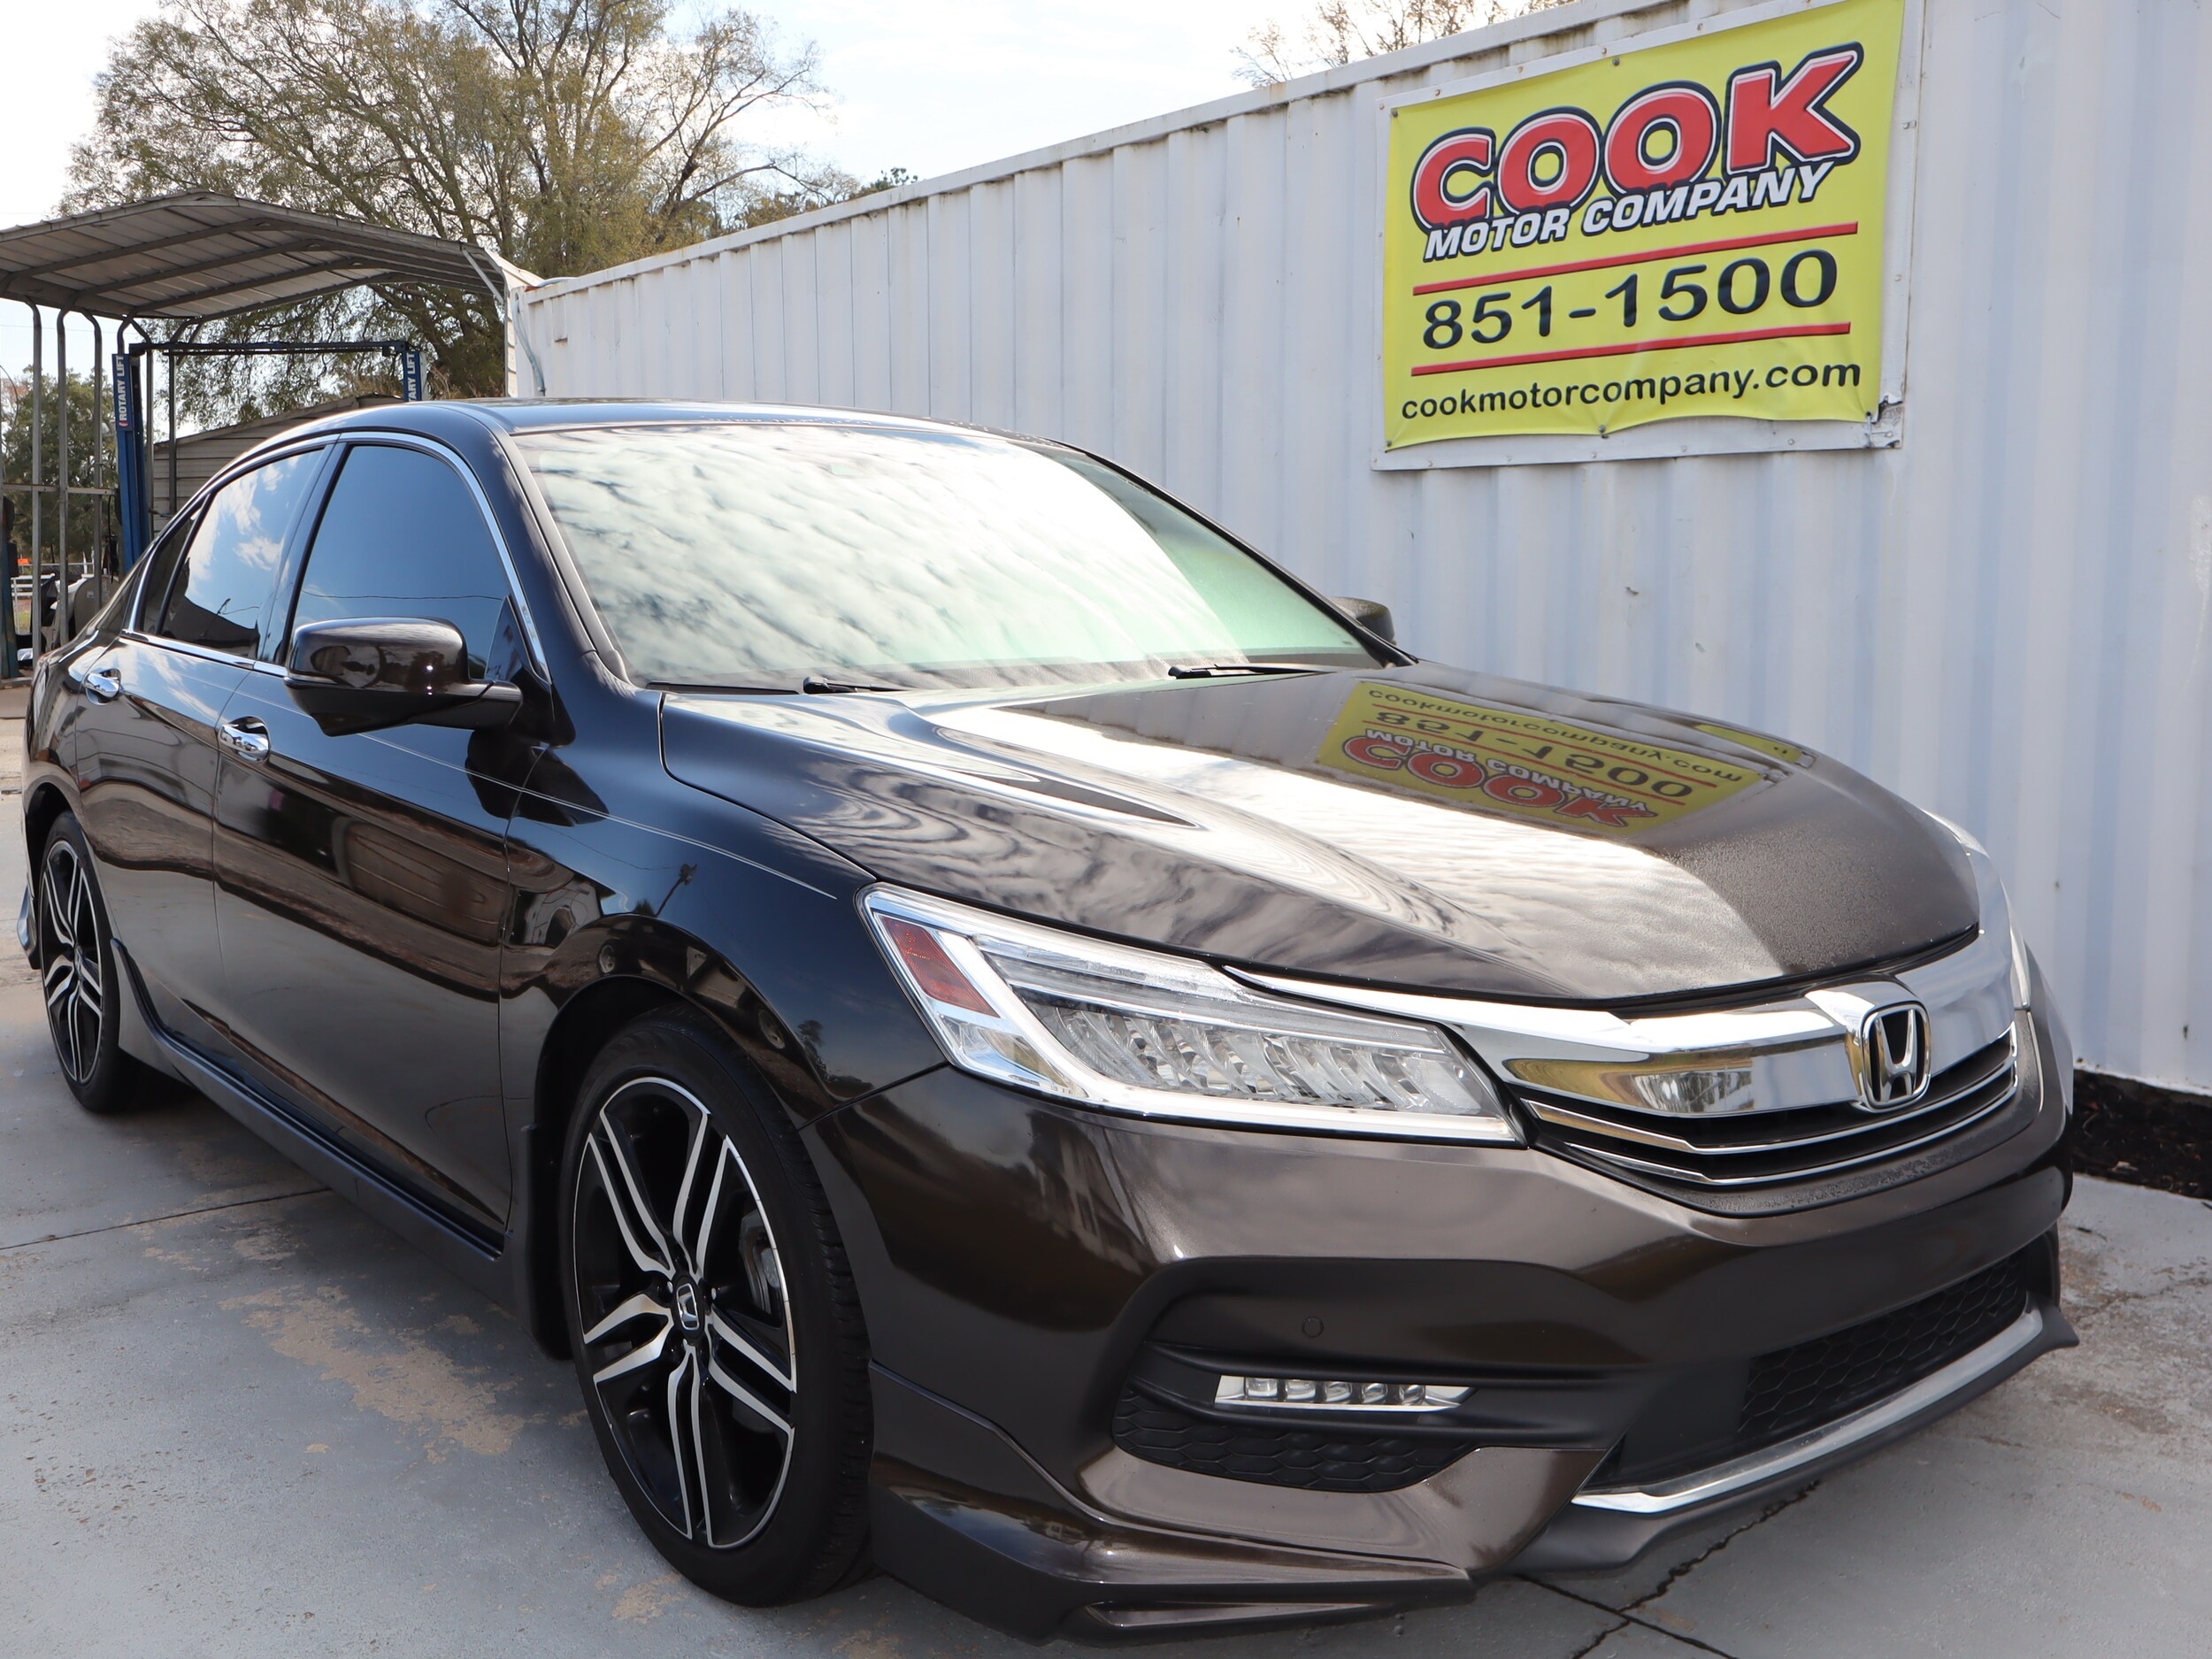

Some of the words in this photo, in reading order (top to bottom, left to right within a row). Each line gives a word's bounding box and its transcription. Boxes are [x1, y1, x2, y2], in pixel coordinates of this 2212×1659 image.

[1411, 42, 1863, 228] COOK
[1424, 207, 1571, 262] MOTOR
[1582, 161, 1834, 236] COMPANY
[1422, 249, 1838, 350] 851-1500
[116, 355, 126, 377] LIFT
[407, 352, 416, 375] LIFT
[1401, 362, 1862, 419] cookmotorcompany.com
[117, 380, 127, 421] ROTARY
